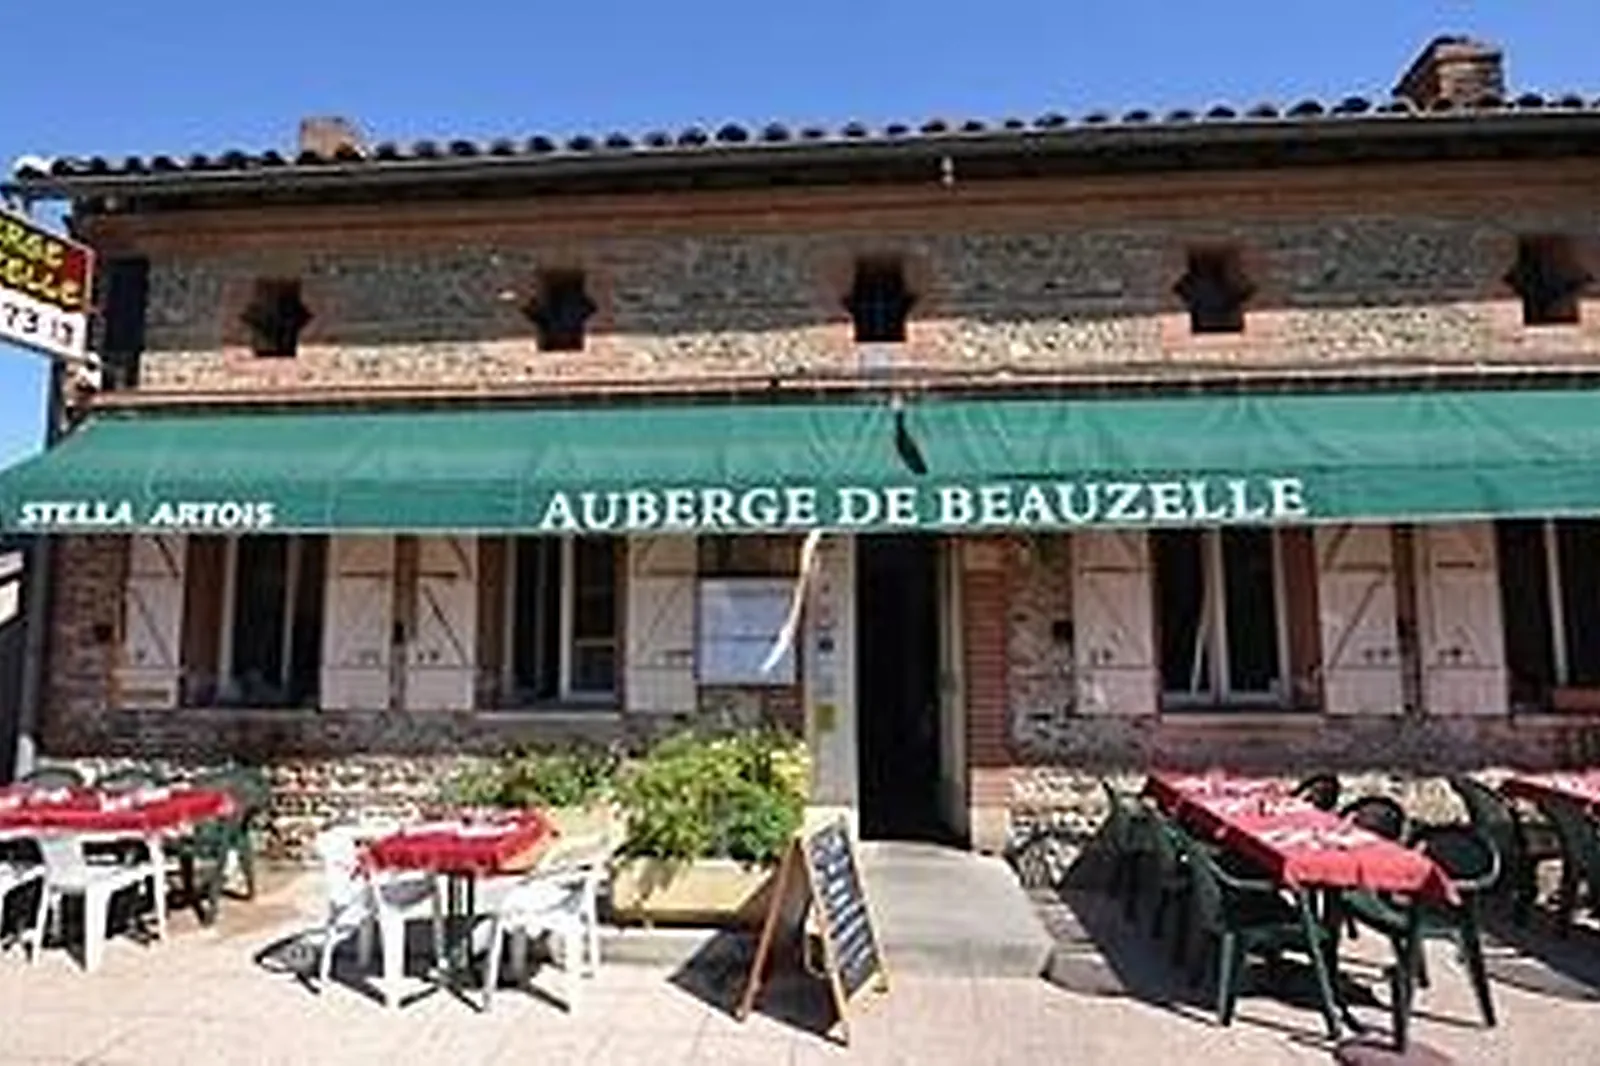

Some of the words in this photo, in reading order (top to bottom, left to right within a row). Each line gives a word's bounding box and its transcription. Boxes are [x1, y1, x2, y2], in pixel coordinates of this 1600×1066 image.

[19, 501, 132, 525] STELLA
[150, 502, 275, 527] ARTOIS
[540, 487, 818, 530] AUBERGE
[837, 486, 919, 526] DE
[939, 479, 1308, 525] BEAUZELLE
